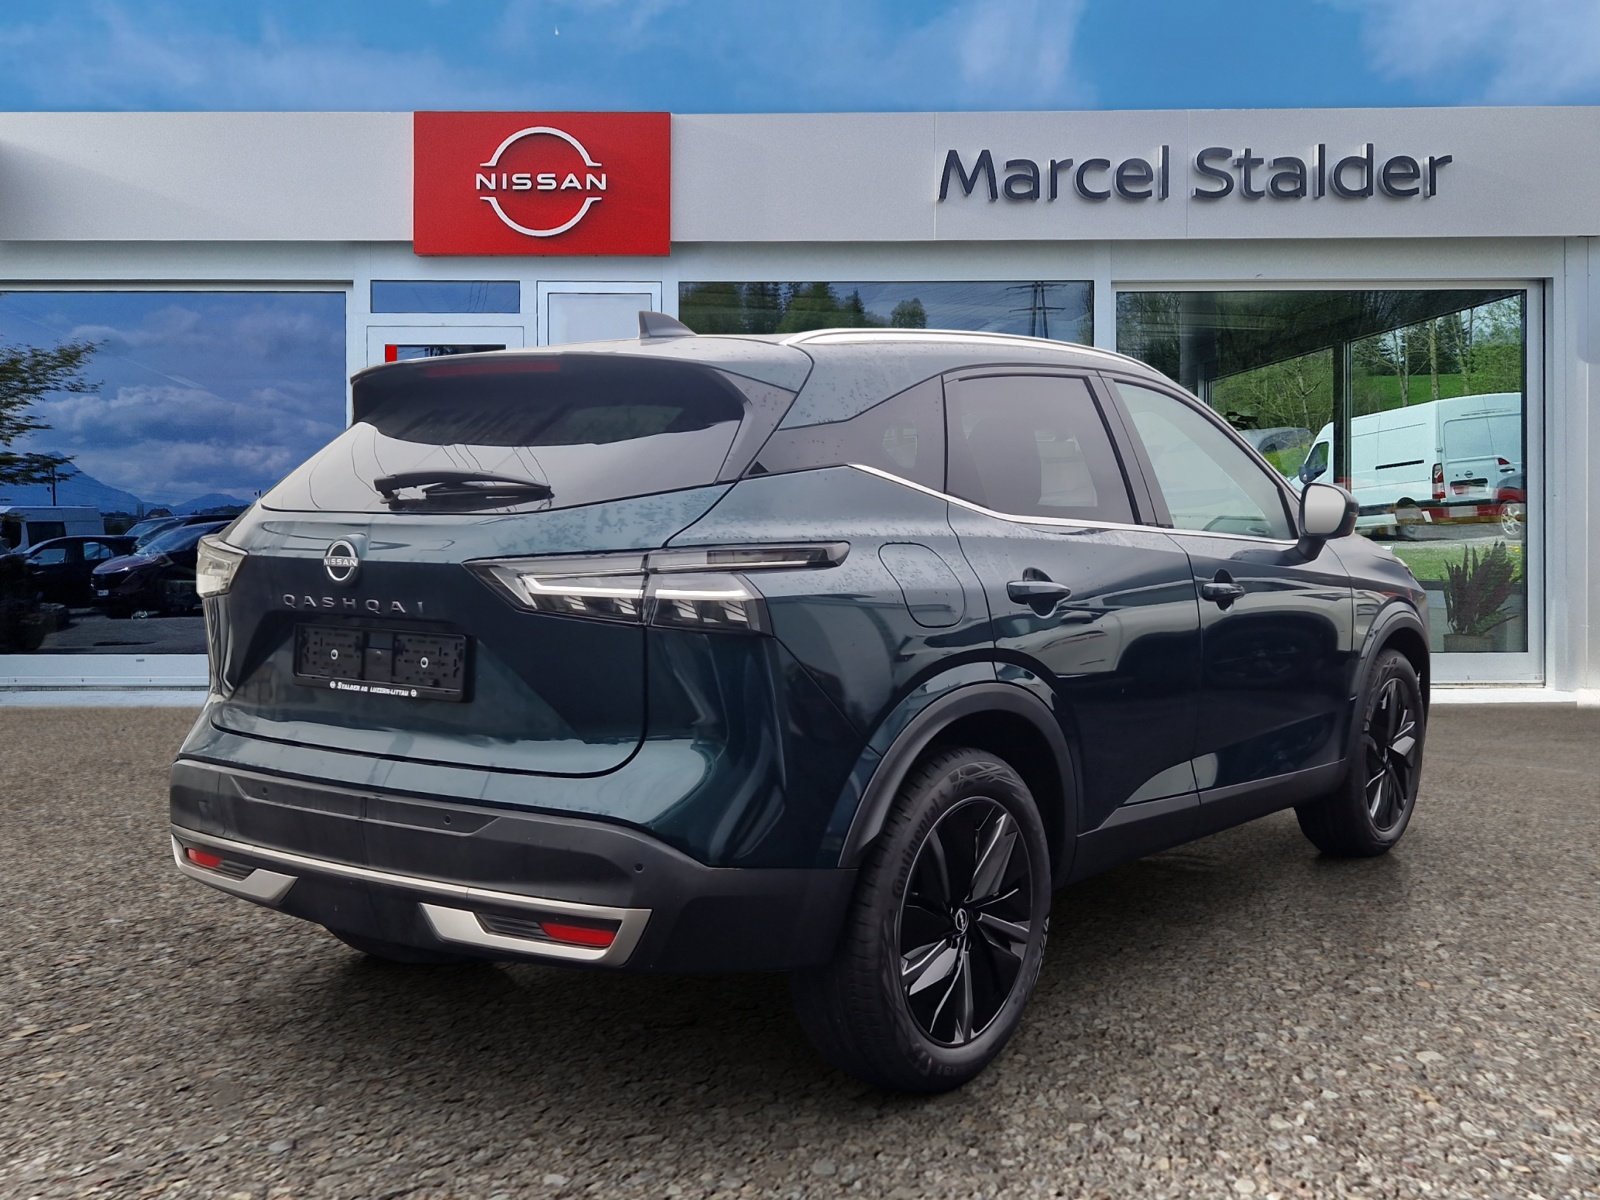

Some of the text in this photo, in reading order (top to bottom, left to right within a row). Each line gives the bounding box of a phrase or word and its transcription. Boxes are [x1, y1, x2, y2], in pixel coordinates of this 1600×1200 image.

[938, 143, 1453, 201] Marcel Stalder
[475, 173, 607, 190] NISSAN
[323, 557, 359, 567] NISSAN
[282, 594, 424, 614] QASHQAI
